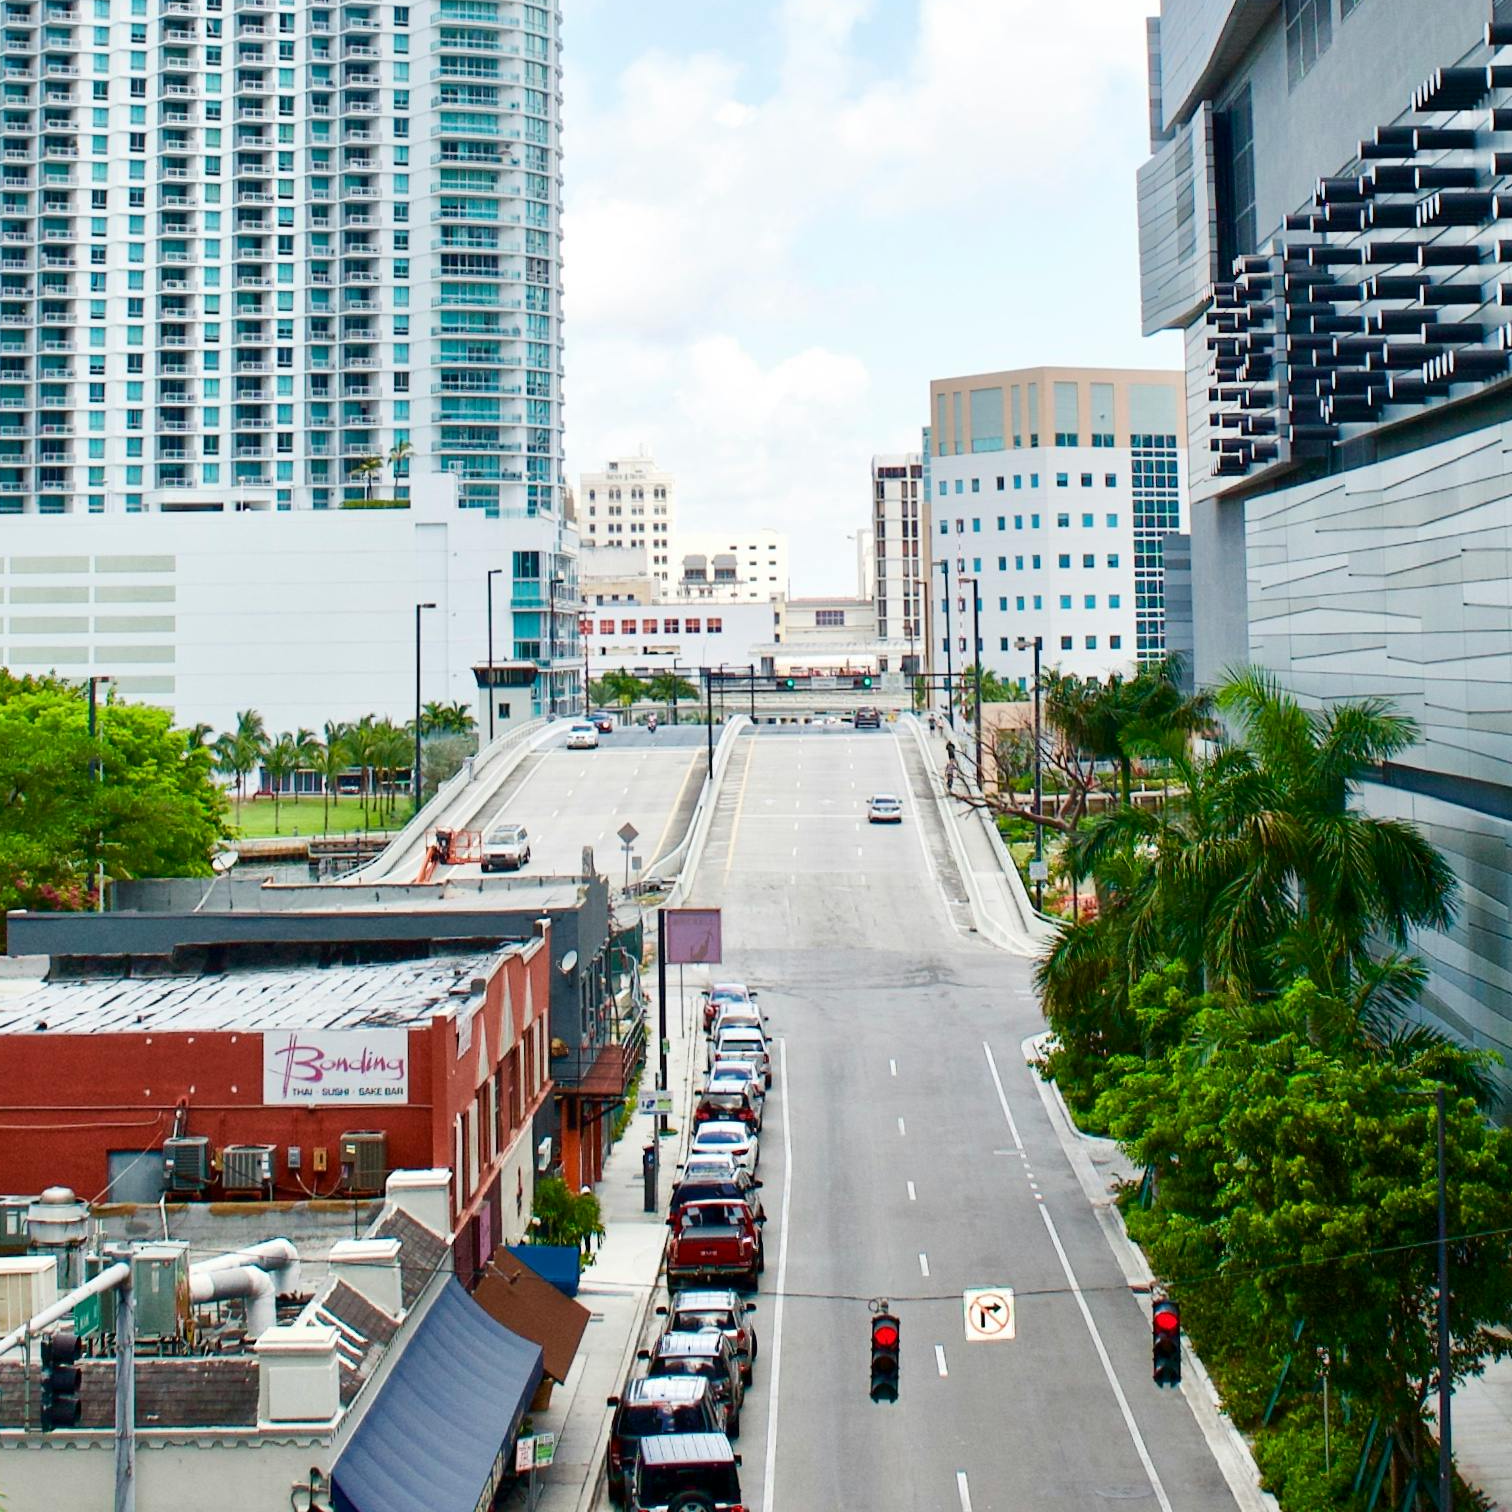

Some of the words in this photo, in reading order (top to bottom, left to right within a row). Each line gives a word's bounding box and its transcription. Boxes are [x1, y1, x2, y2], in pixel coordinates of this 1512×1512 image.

[268, 1033, 405, 1099] Bonding
[292, 1088, 313, 1096] THAI
[322, 1088, 350, 1096] SUSHI
[385, 1088, 404, 1096] BAR
